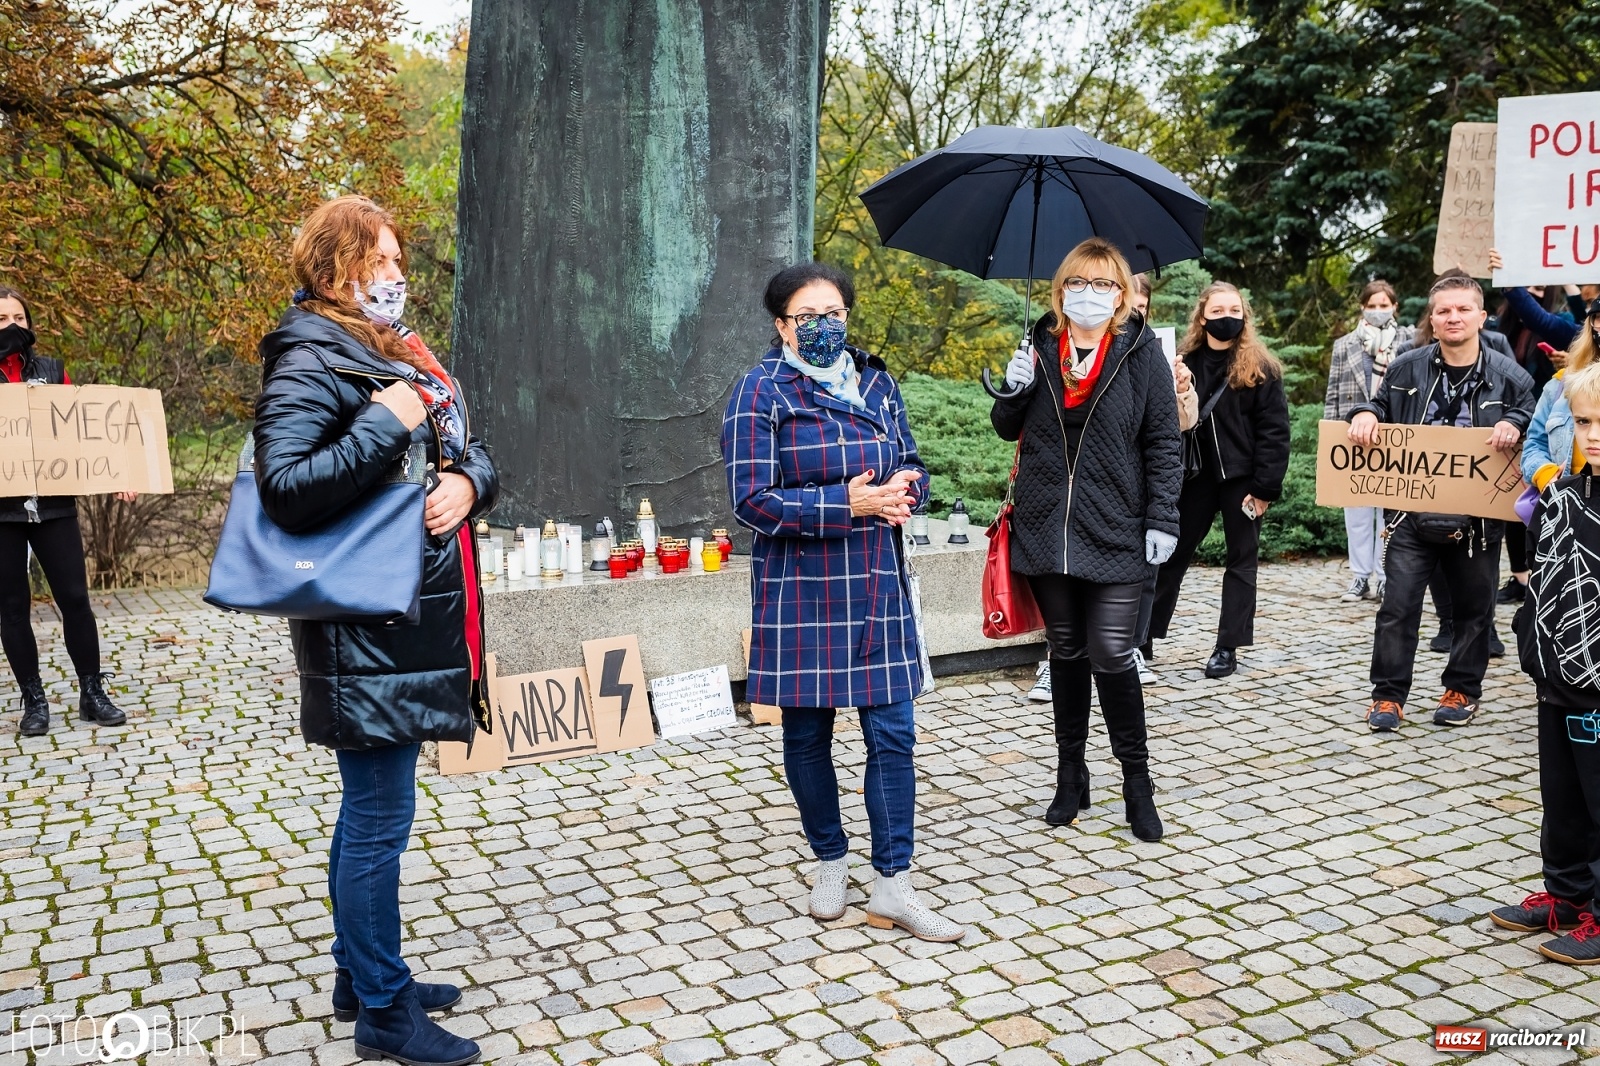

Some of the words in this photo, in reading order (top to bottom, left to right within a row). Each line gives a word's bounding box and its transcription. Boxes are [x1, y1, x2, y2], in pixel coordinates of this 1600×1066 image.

[1530, 120, 1600, 159] POL
[1542, 224, 1600, 268] EU
[50, 399, 144, 446] MEGA
[1374, 427, 1415, 448] STOP
[1330, 444, 1491, 482] OBOWIĄZEK
[1350, 474, 1436, 500] SZCZEPIEŃ
[499, 676, 594, 752] WARA
